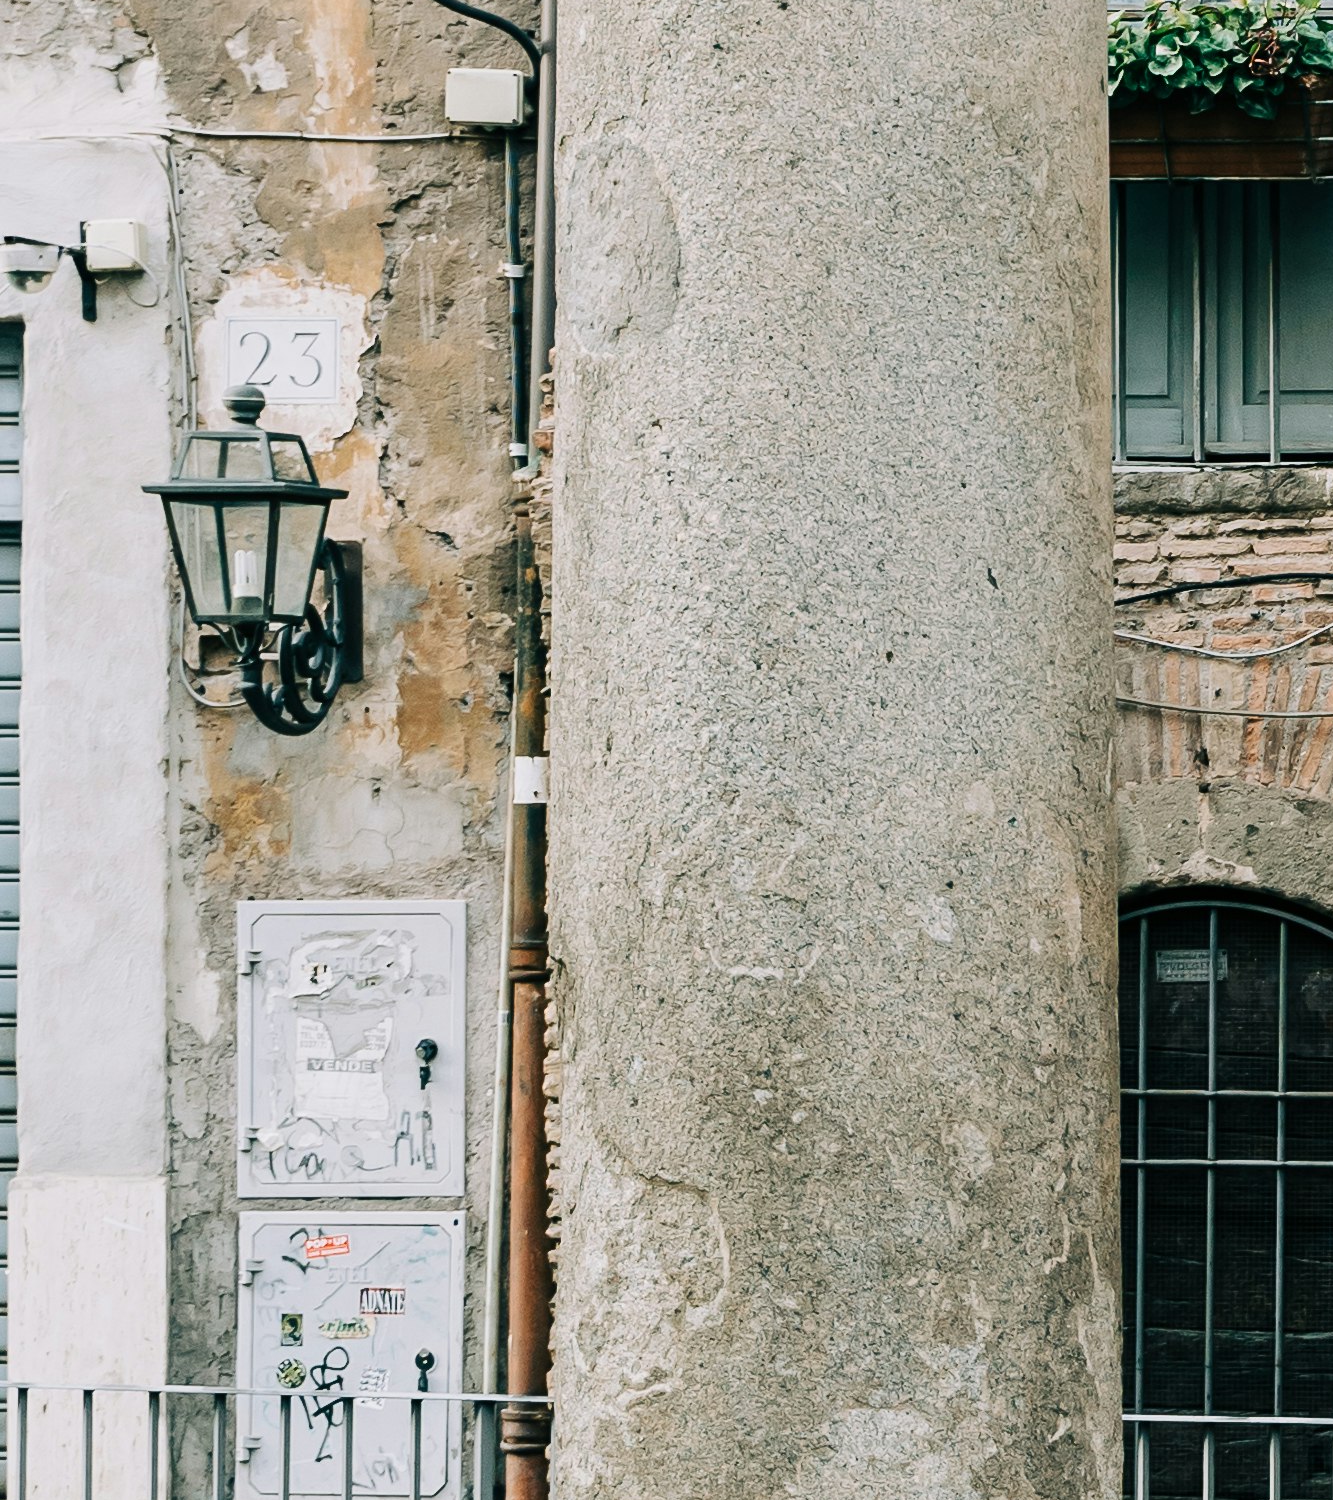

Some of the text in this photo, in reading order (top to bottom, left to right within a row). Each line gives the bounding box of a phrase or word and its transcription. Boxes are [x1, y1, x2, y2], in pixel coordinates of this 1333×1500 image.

[240, 331, 322, 388] 23
[311, 1059, 373, 1073] VENDE
[360, 1289, 405, 1313] ADNATE
